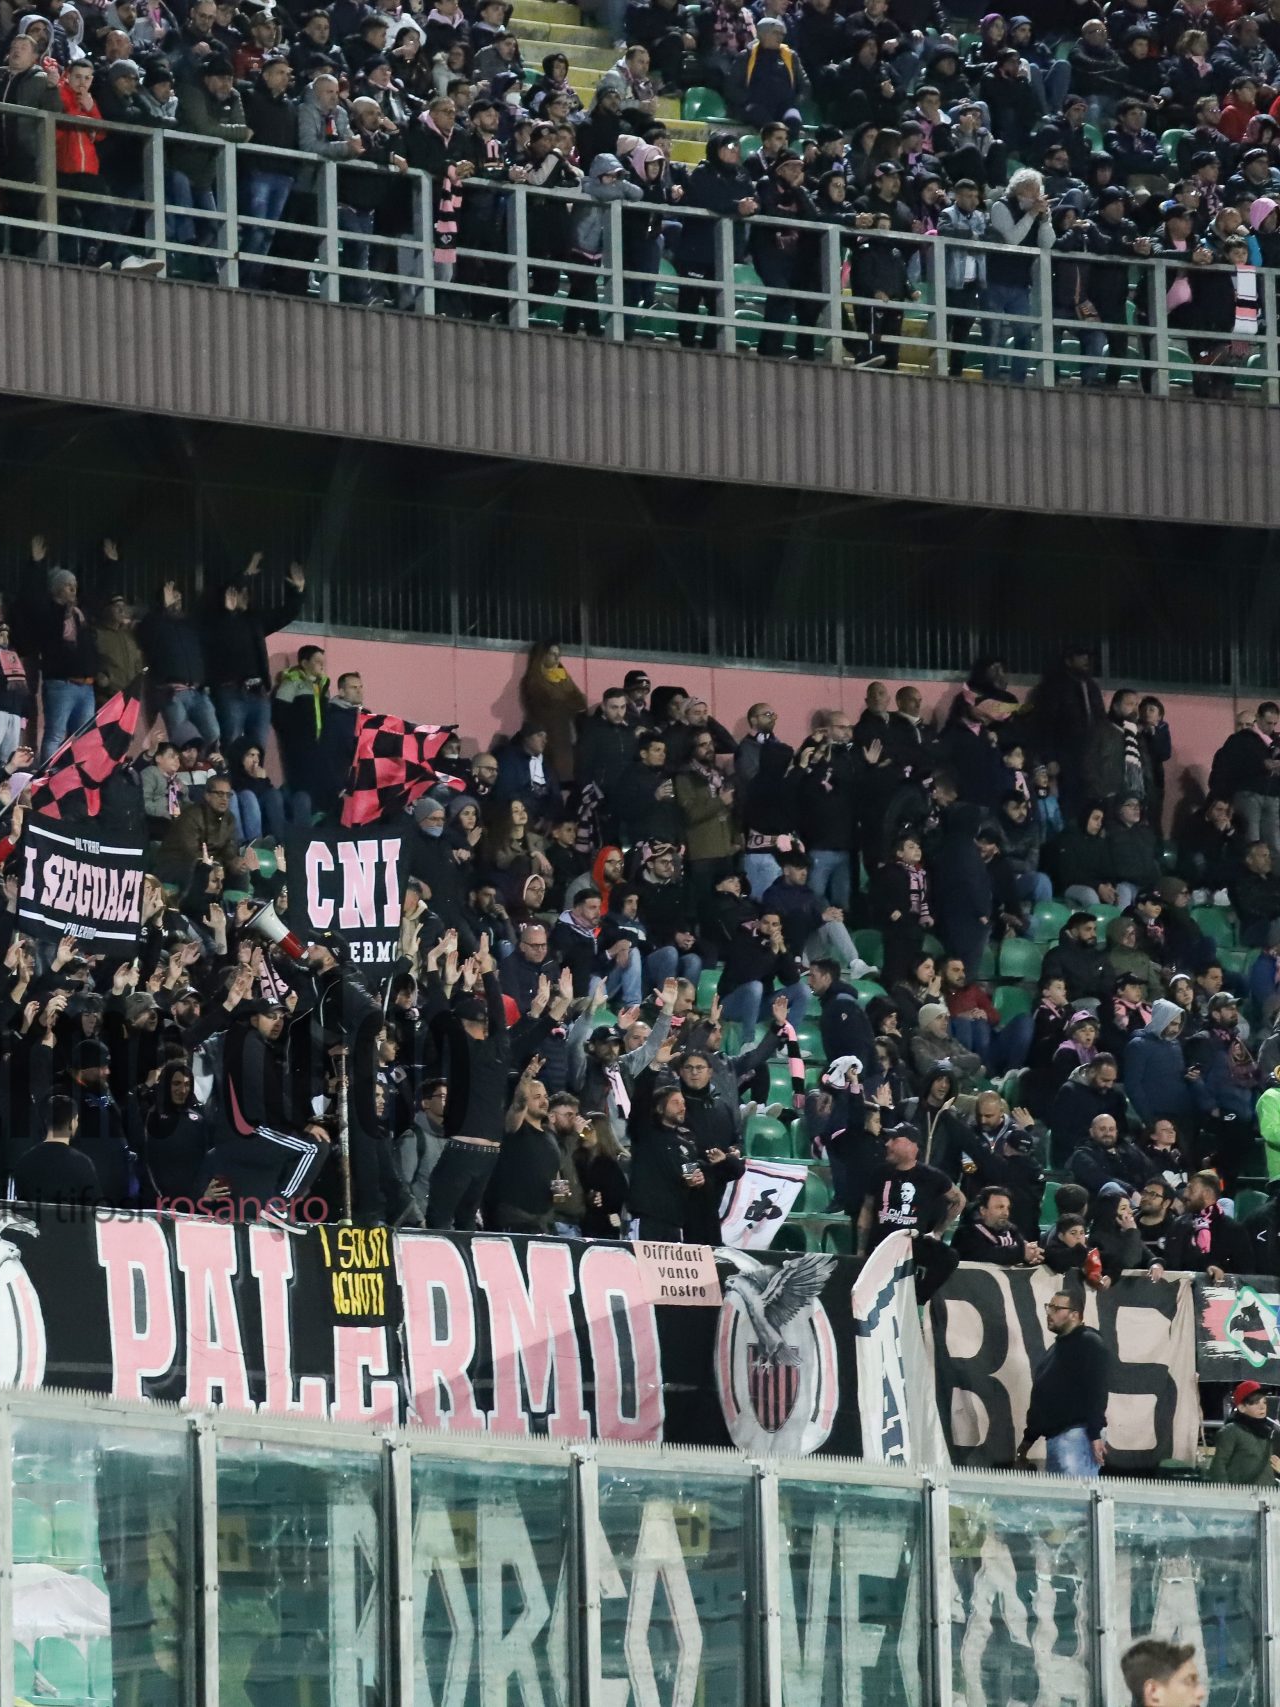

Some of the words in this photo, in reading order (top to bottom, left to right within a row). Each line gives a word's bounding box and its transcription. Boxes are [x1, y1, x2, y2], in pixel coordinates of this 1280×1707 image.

[20, 845, 37, 900] I
[40, 853, 143, 923] SEGUACI
[305, 838, 401, 929] CNI
[643, 1245, 703, 1262] Diffidati
[661, 1285, 706, 1298] nostro
[96, 1215, 666, 1442] PALERMO
